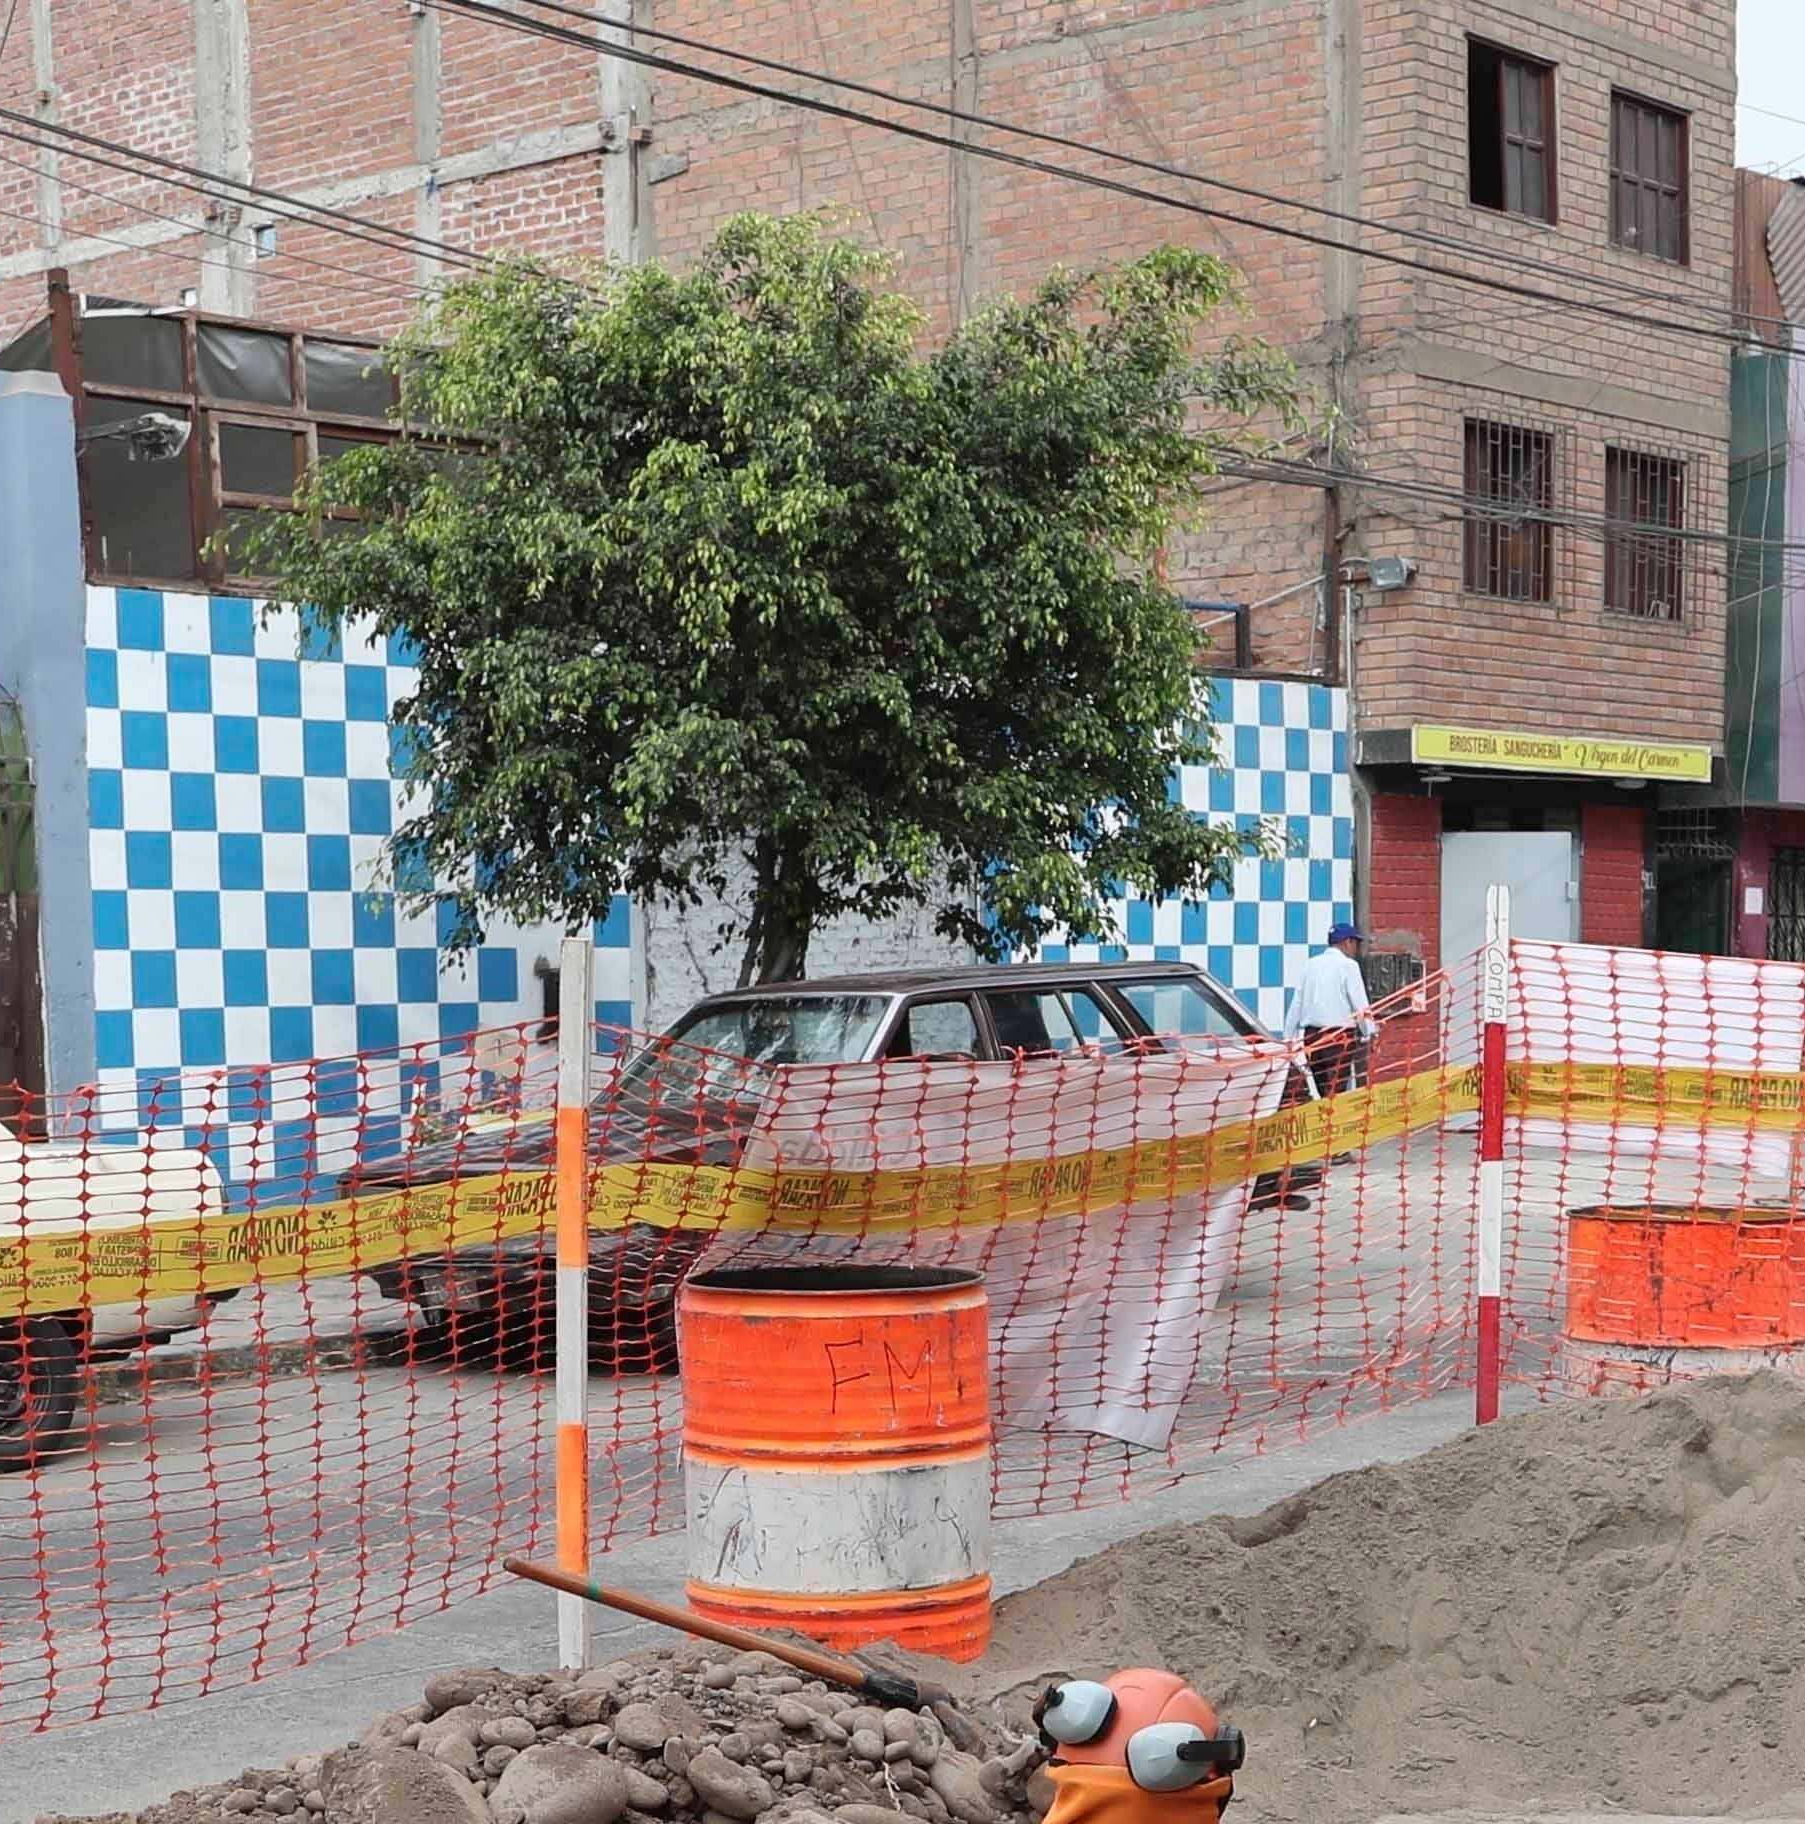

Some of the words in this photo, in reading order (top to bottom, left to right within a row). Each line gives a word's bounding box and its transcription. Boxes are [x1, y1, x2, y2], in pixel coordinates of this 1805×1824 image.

[1450, 735, 1497, 754] BROSTERÍA
[1574, 743, 1618, 767] Virgen
[1620, 748, 1636, 765] del
